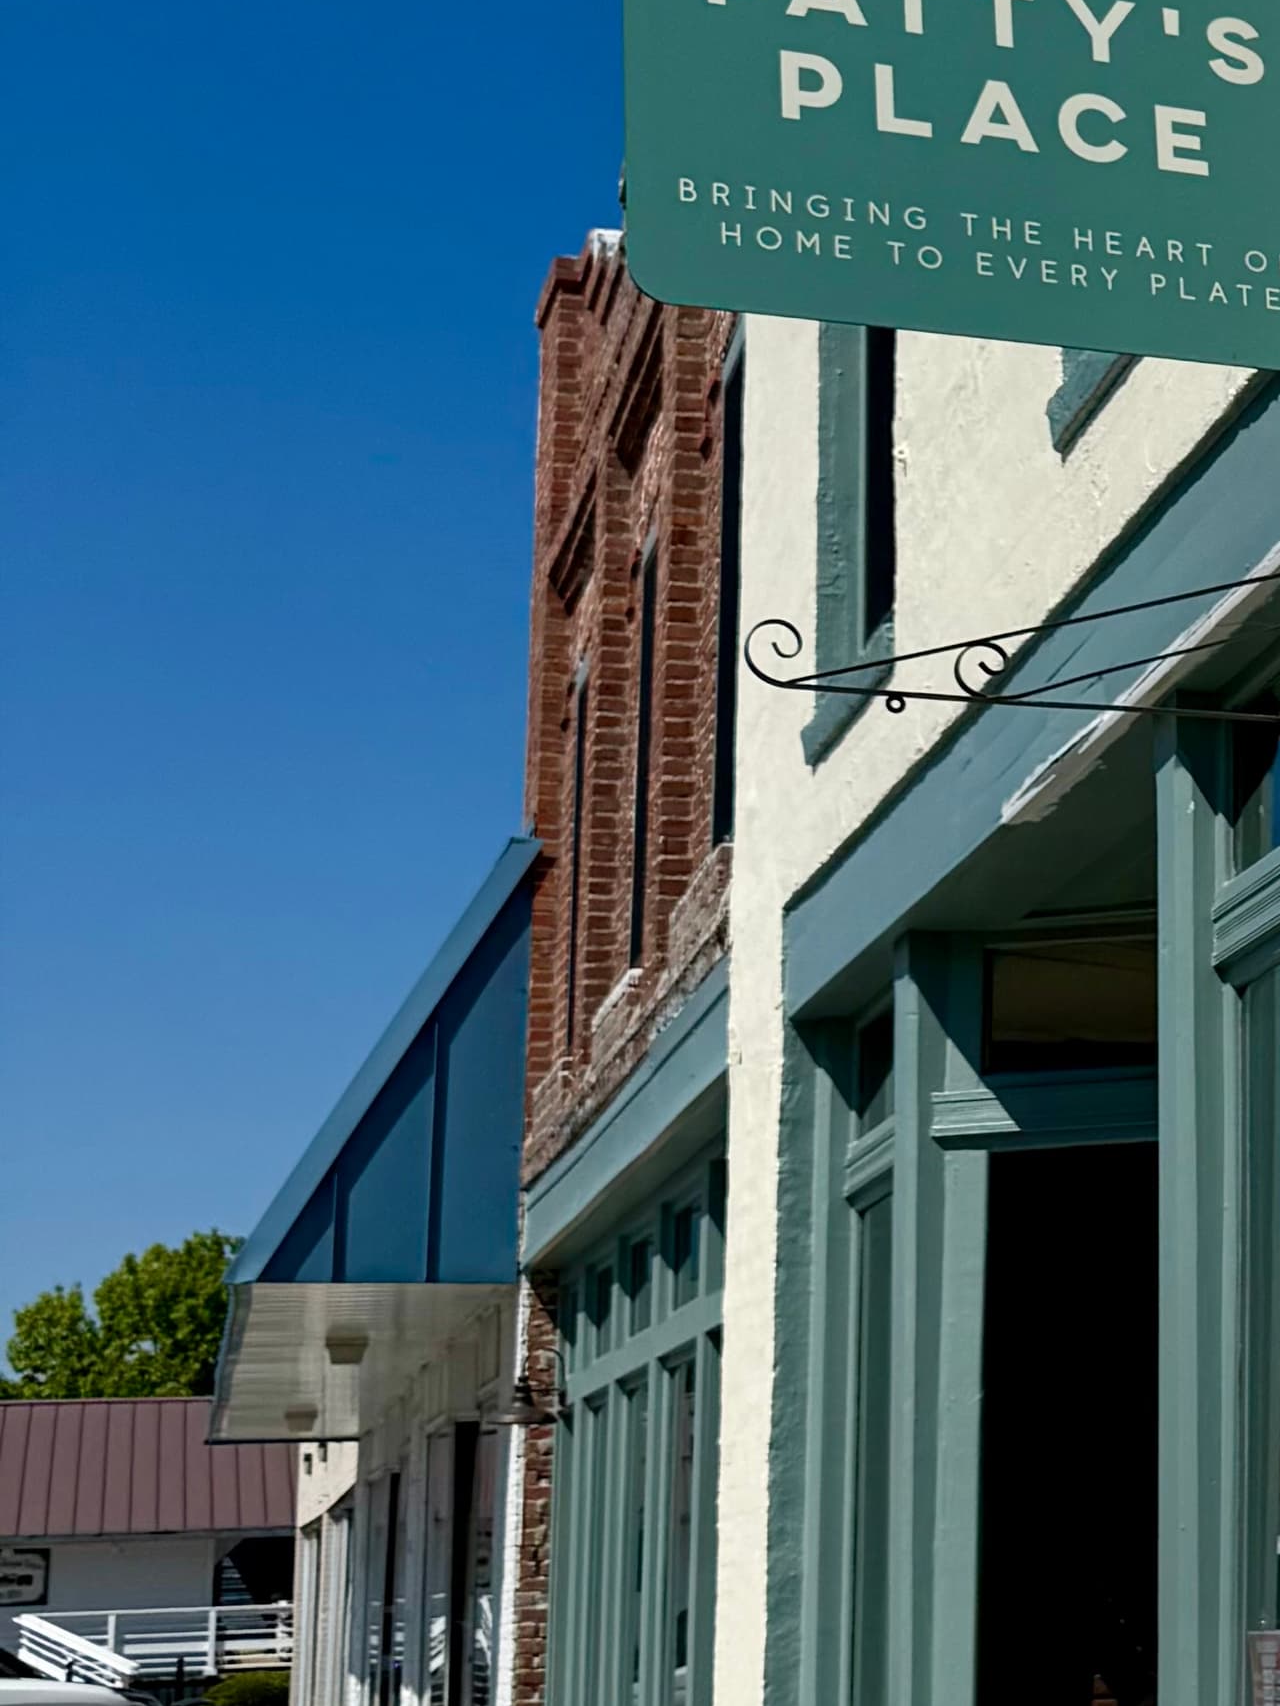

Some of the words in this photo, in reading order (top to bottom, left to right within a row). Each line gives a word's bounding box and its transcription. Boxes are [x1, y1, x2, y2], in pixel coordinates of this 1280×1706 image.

[780, 50, 1209, 176] PLACE
[678, 177, 928, 231] BRINGING
[959, 212, 1043, 246] THE
[1074, 228, 1214, 267] HEART
[720, 221, 854, 260] HOME
[886, 241, 943, 270] TO
[976, 252, 1120, 292] EVERY
